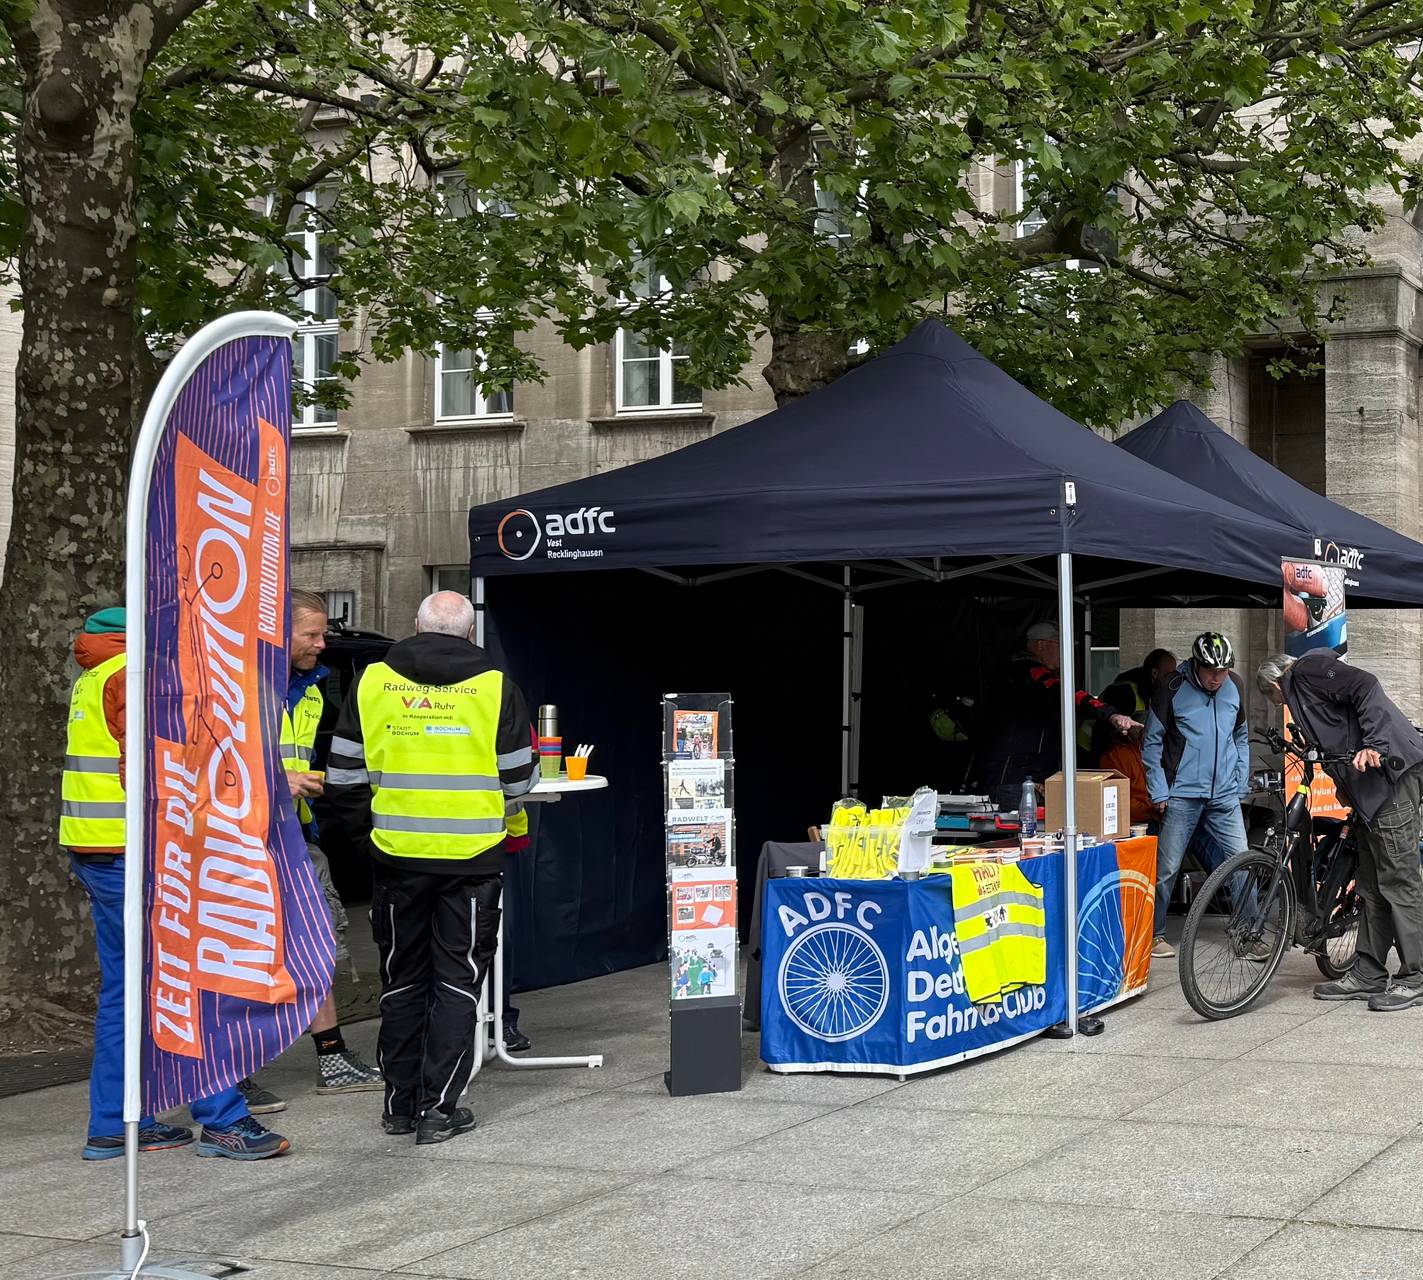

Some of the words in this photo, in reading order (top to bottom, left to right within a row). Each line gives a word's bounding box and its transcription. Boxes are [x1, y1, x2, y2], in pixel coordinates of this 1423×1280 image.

[268, 445, 277, 476] adfc
[545, 507, 616, 536] adfc
[547, 539, 562, 547] Vest
[547, 548, 604, 560] Recklinghausen
[1296, 565, 1312, 579] adfc
[1340, 547, 1364, 570] adfc
[257, 510, 282, 637] RADVOLUTION.DE
[383, 682, 477, 694] Radweg-Service
[434, 702, 456, 710] Ruhr
[164, 750, 200, 837] DIE
[158, 850, 192, 939] FÜR
[777, 891, 882, 937] ADFC
[155, 943, 194, 1043] ZEIT
